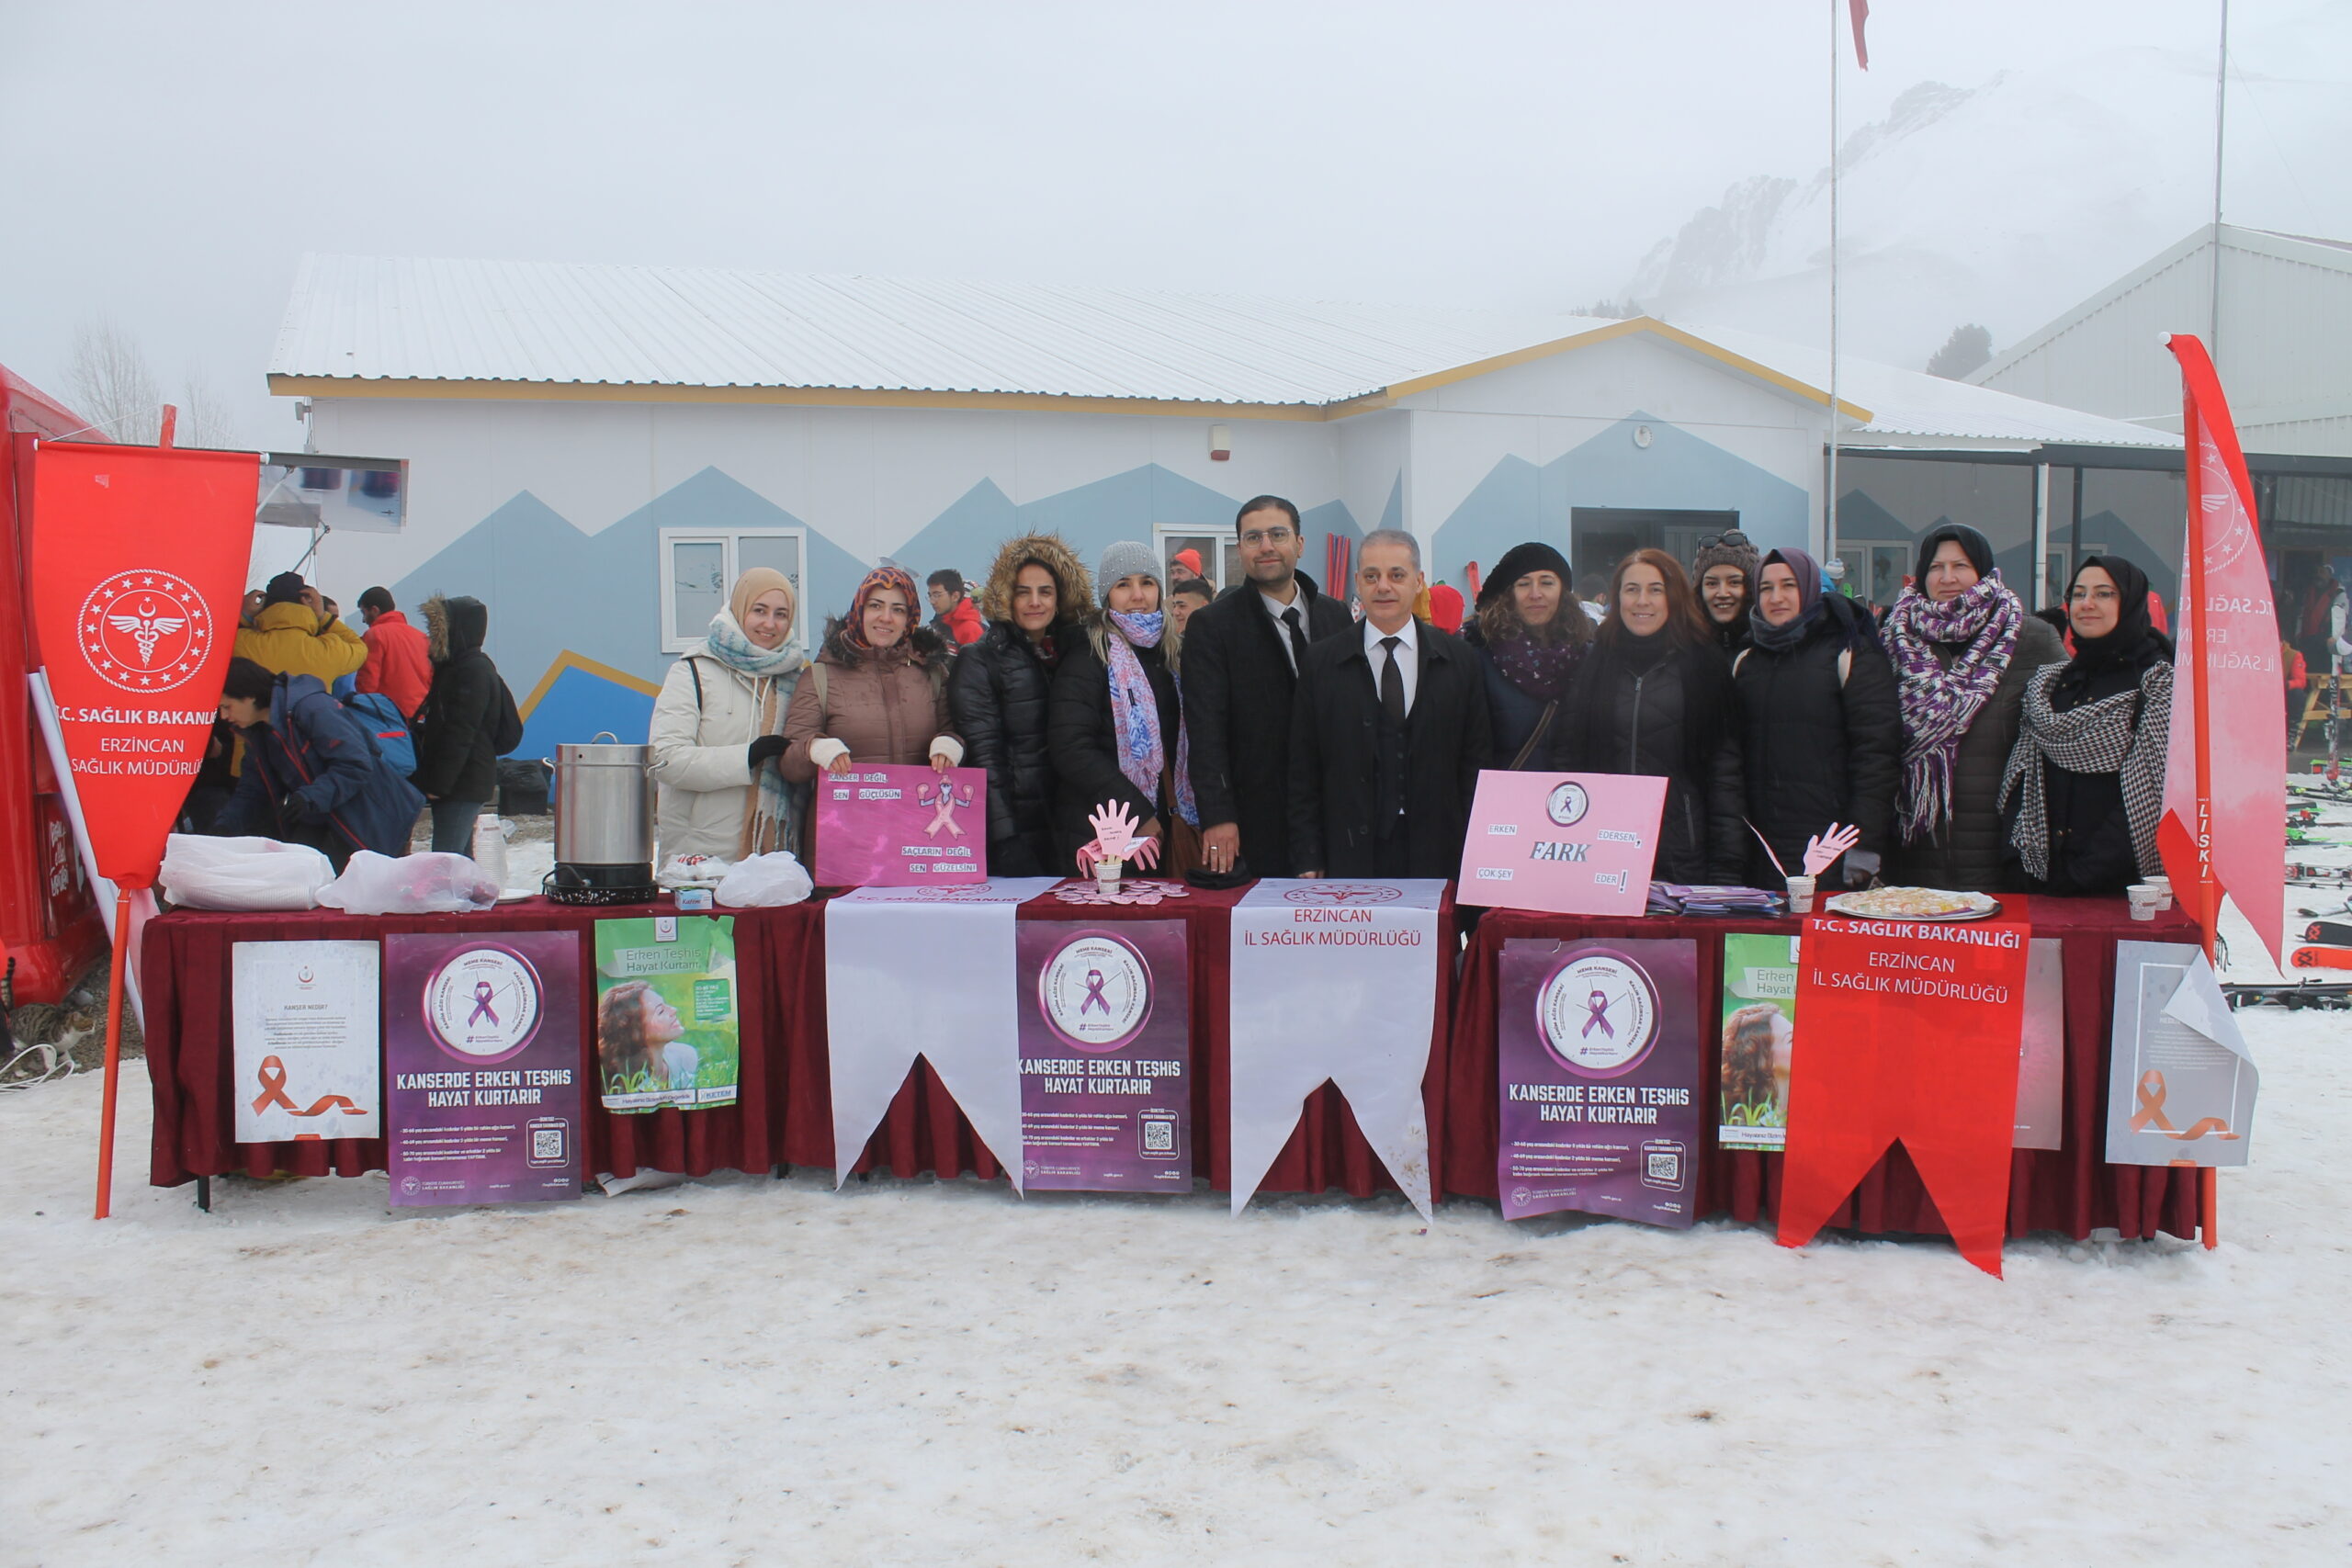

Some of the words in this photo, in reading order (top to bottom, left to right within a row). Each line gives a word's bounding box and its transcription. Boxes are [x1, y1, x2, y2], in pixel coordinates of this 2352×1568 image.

[79, 706, 142, 724] SAĞLIK
[147, 708, 217, 725] BAKANLI
[101, 737, 184, 752] ERZİNCAN
[73, 758, 123, 774] SAĞLIK
[127, 759, 202, 776] MÜDÜRLÜ
[859, 790, 900, 799] GÜÇLÜSÜN
[1488, 825, 1516, 833] ERKEN
[902, 847, 942, 856] SAÇLARIN
[1530, 841, 1591, 863] FARK
[1478, 868, 1498, 878] ÇOK
[1498, 870, 1513, 879] ŞEY
[1295, 908, 1372, 923] ERZİNCAN
[1245, 931, 1257, 945] İL
[1261, 930, 1315, 945] SAĞLIK
[1318, 930, 1420, 946] MÜDÜRLÜĞÜ
[1813, 919, 1844, 933] T.C.
[1848, 920, 1914, 938] SAĞLIK
[1917, 925, 2020, 949] BAKANLIĞI
[627, 950, 661, 961] Erken
[664, 948, 701, 960] Teşhis
[1869, 952, 1955, 974] ERZİNCAN
[627, 963, 659, 974] Hayat
[1757, 969, 1794, 983] Erken
[1757, 983, 1792, 996] Hayat
[1813, 968, 1826, 986] İL
[1831, 972, 1890, 992] SAĞLIK
[1894, 977, 2008, 1004] MÜDÜRLÜĞÜ
[1018, 1059, 1085, 1075] KANSERDE
[1088, 1060, 1131, 1076] ERKEN
[397, 1072, 471, 1089] KANSERDE
[475, 1070, 521, 1088] ERKEN
[1045, 1077, 1084, 1094] HAYAT
[1088, 1078, 1151, 1095] KURTARIR
[428, 1090, 470, 1107] HAYAT
[474, 1089, 541, 1106] KURTARIR
[1509, 1084, 1584, 1102] KANSERDE
[1588, 1086, 1635, 1103] ERKEN
[1540, 1105, 1583, 1122] HAYAT
[1588, 1106, 1657, 1124] KURTARIR
